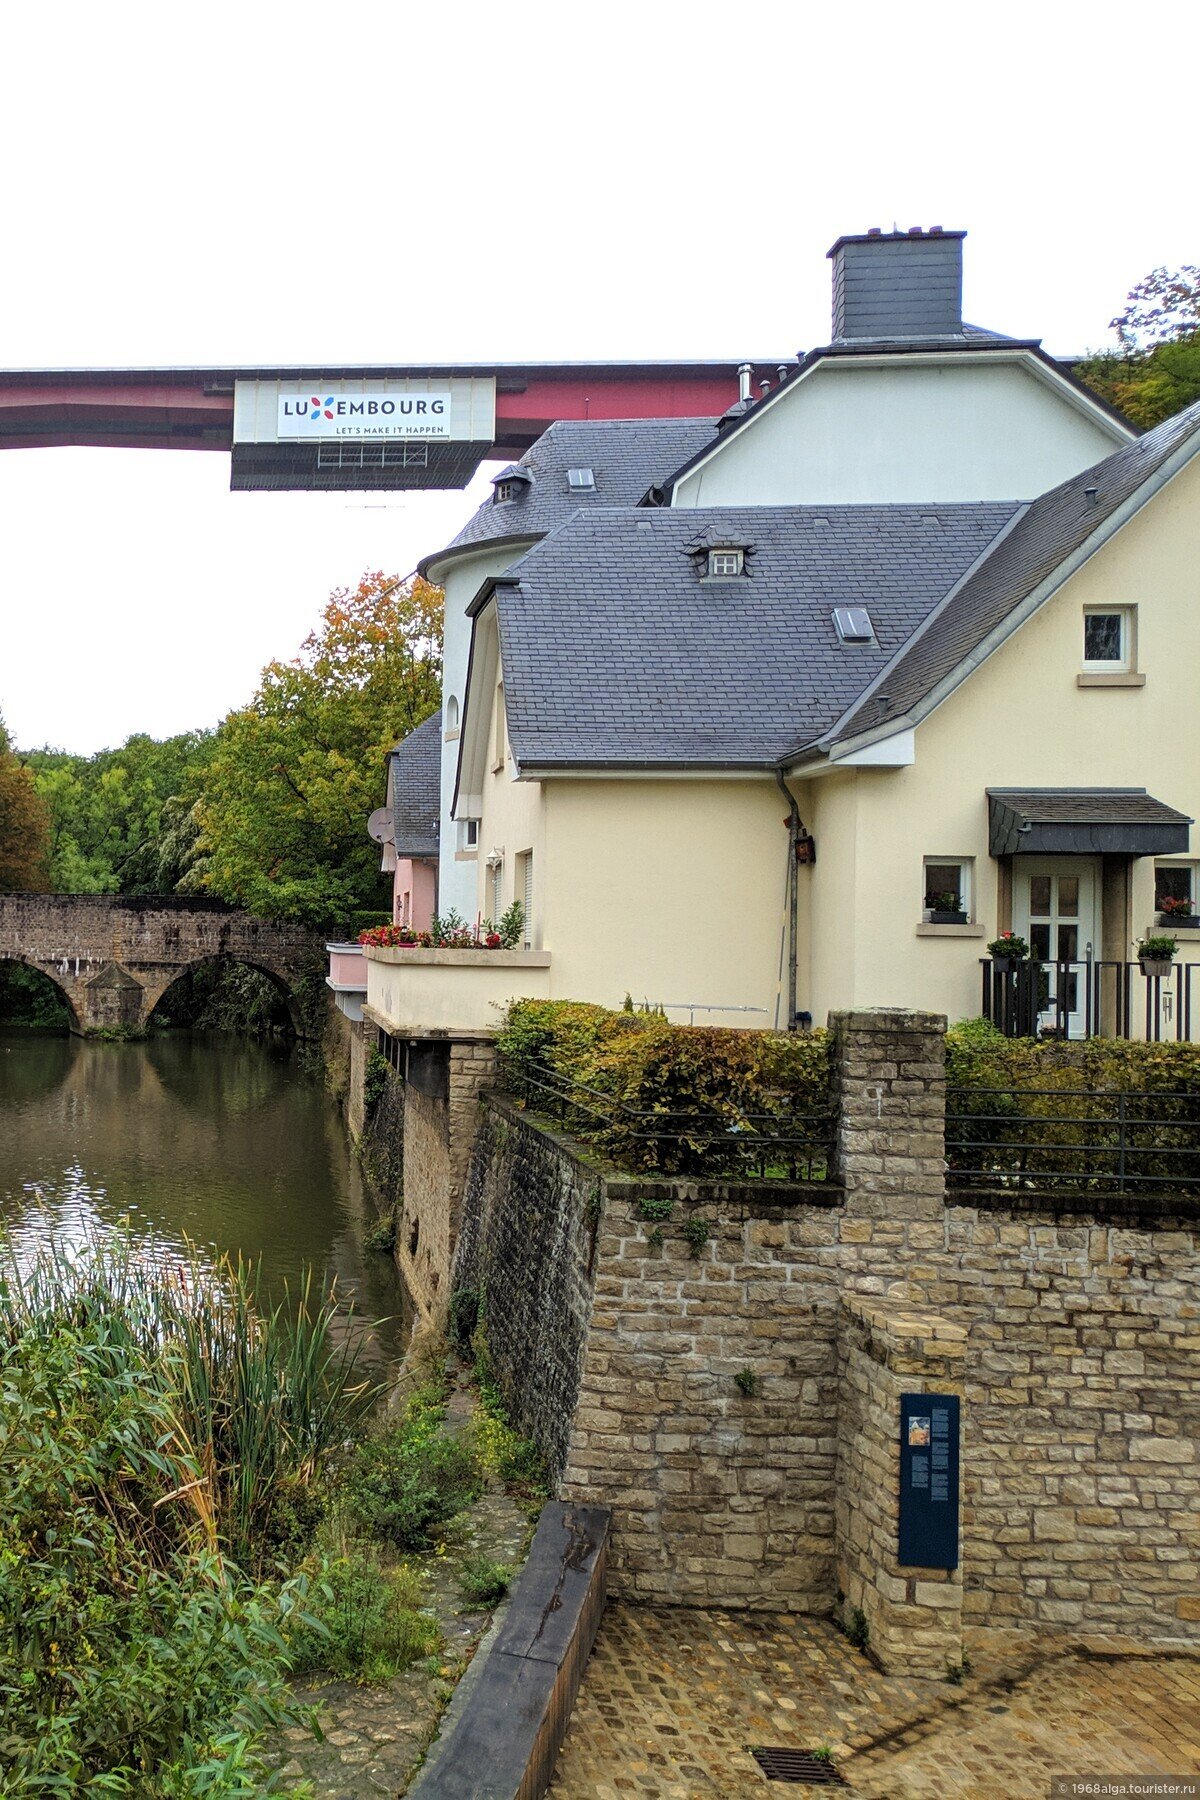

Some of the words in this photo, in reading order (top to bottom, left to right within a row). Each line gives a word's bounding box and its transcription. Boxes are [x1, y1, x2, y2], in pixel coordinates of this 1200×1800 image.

[284, 397, 444, 420] LUXEMBOURG
[336, 427, 361, 435] LET'S
[406, 426, 444, 434] HAPPEN
